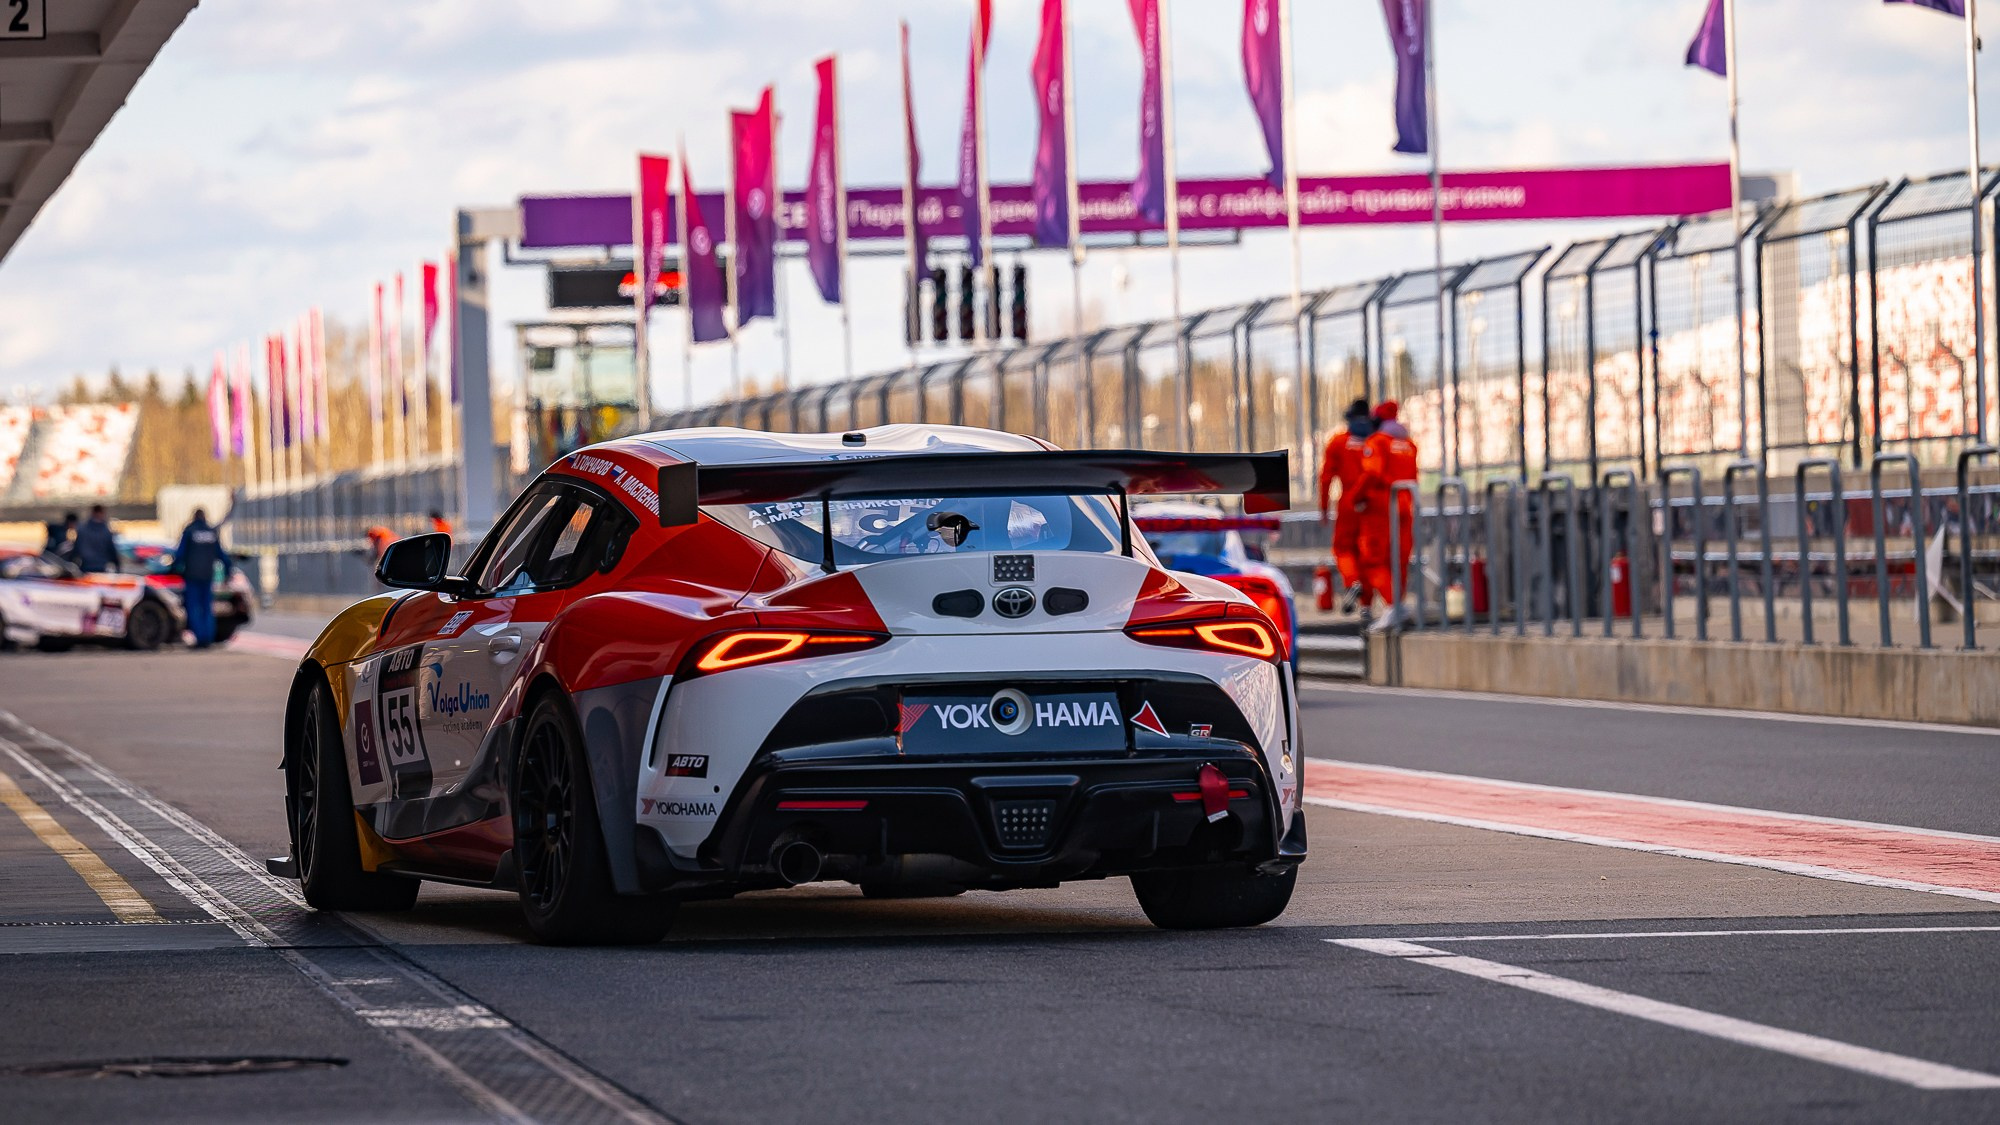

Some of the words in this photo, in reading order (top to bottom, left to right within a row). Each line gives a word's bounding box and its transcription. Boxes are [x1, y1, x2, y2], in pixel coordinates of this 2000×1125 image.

[934, 701, 1120, 729] YOKHAMA
[387, 691, 416, 758] 55
[443, 720, 460, 734] cycling
[461, 720, 483, 732] academy
[1191, 729, 1210, 737] GR
[656, 801, 718, 816] YOKOHAMA
